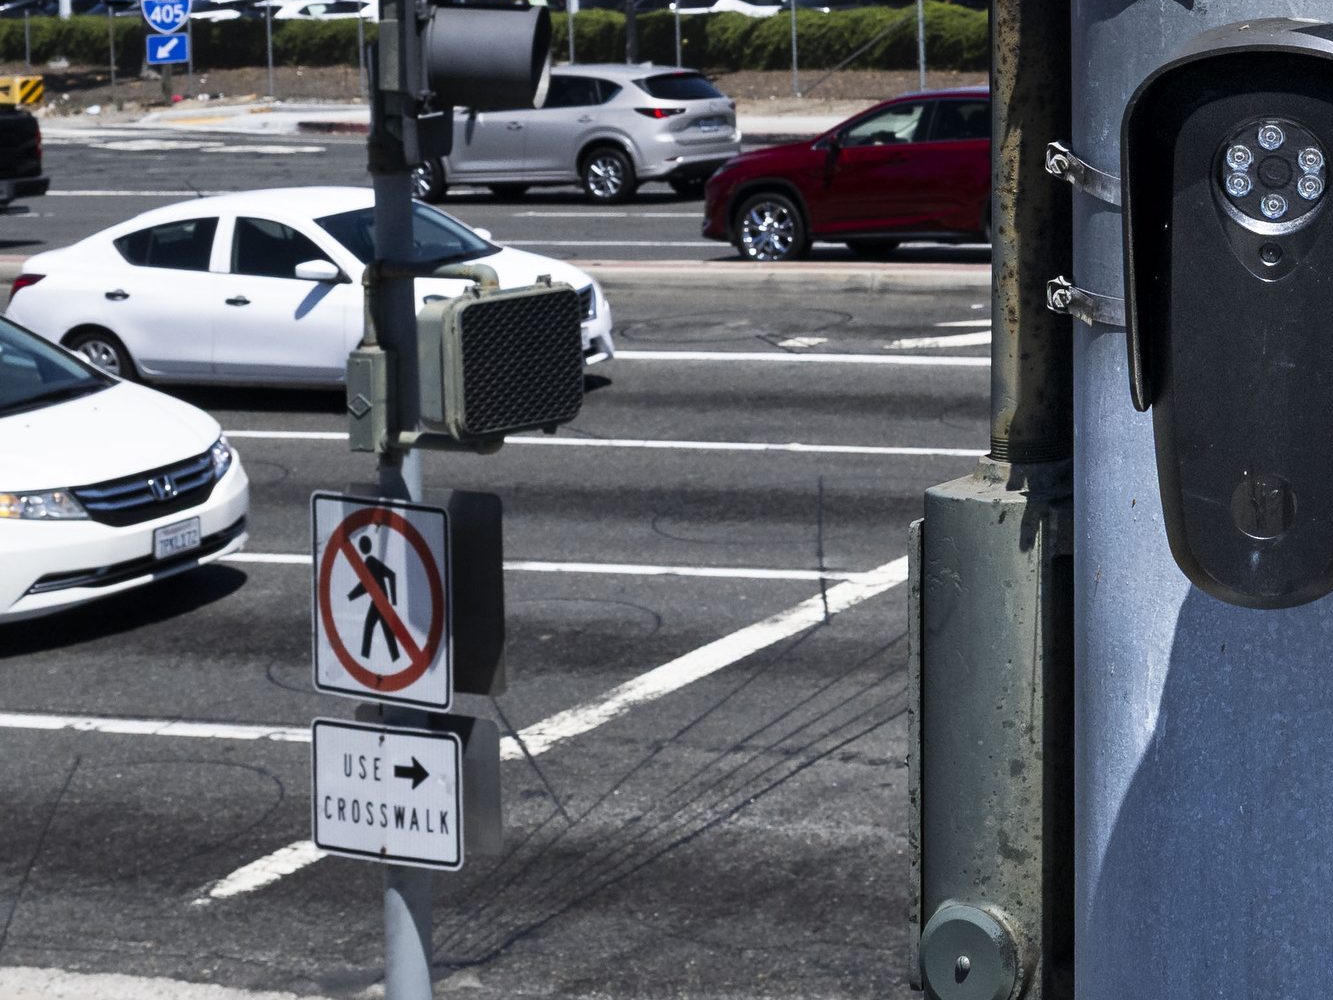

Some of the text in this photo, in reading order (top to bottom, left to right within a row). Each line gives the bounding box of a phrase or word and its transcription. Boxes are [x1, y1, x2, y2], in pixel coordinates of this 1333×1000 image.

[149, 4, 185, 24] 405
[343, 753, 382, 782] USE
[323, 795, 449, 835] CROSSWALK
